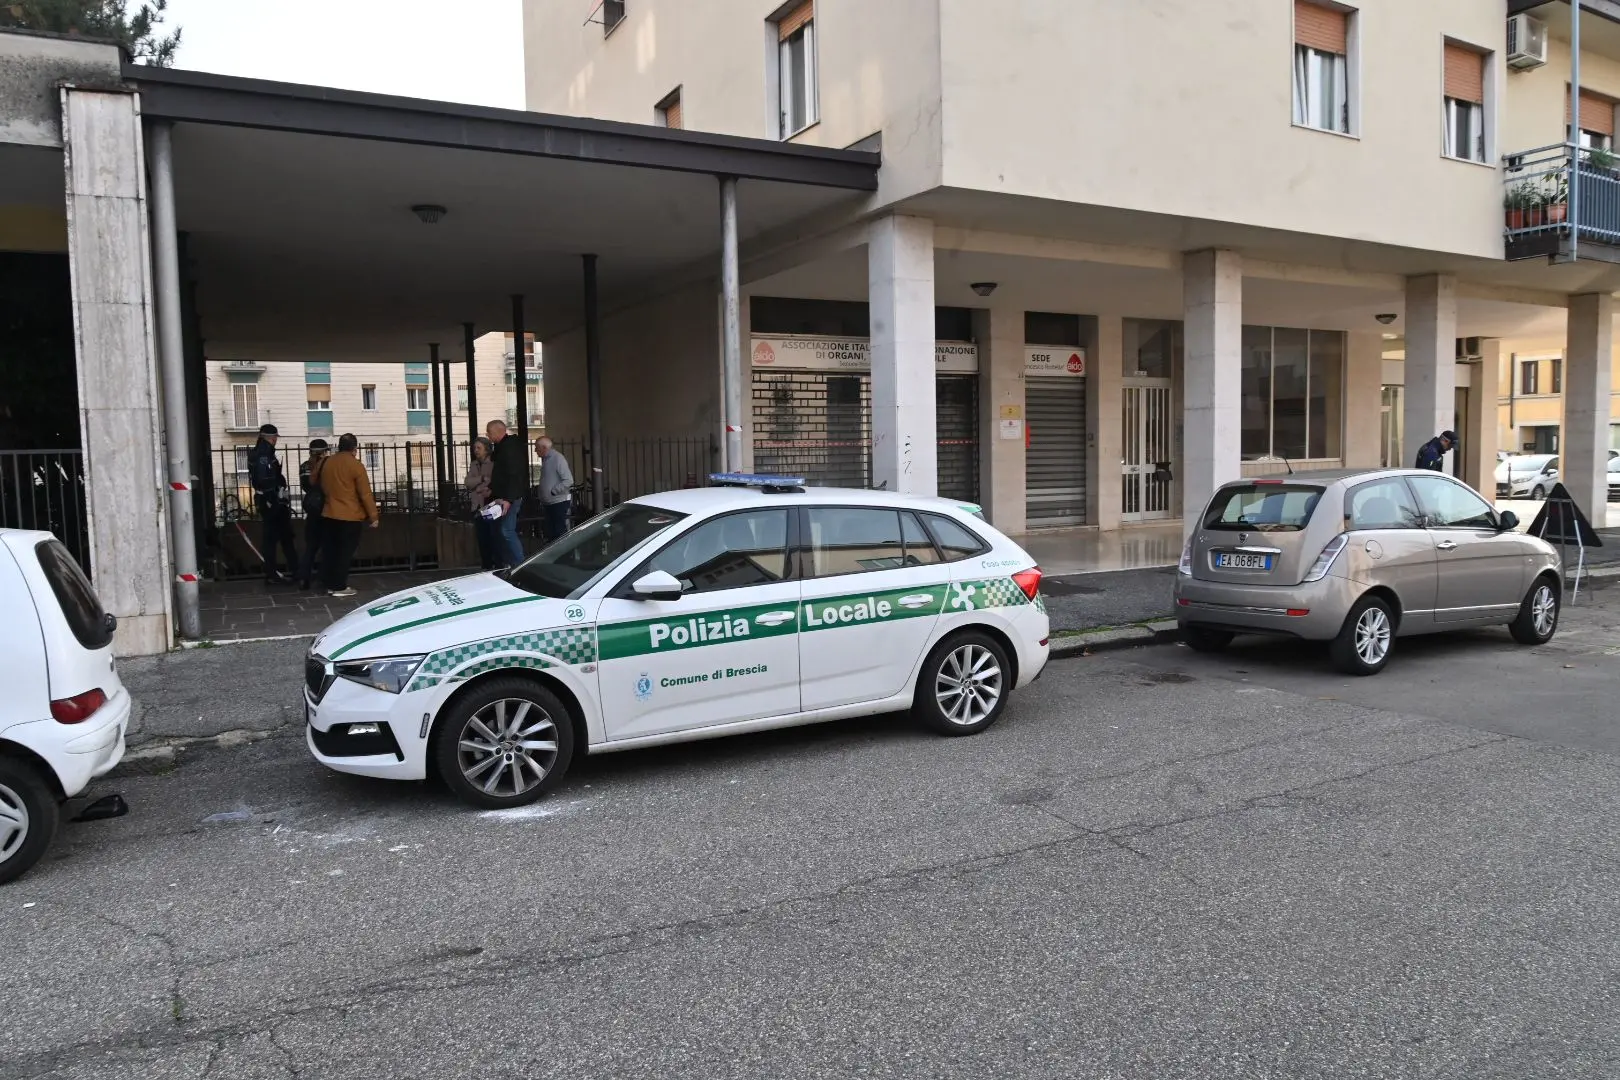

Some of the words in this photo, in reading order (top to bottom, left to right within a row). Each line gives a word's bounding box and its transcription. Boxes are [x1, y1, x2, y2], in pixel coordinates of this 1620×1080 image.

[781, 341, 850, 351] ASSOCIAZIONE
[852, 343, 870, 352] ITAL
[815, 351, 825, 360] DI
[827, 352, 867, 362] ORGANI,
[1031, 354, 1051, 362] SEDE
[1067, 361, 1083, 371] aido
[1221, 554, 1232, 566] EA
[1234, 555, 1264, 568] 068FL
[567, 608, 584, 618] 28
[649, 614, 750, 648] Polizia
[805, 597, 892, 627] Locale
[660, 673, 708, 688] Comune
[711, 669, 723, 680] di
[726, 663, 768, 678] Brescia
